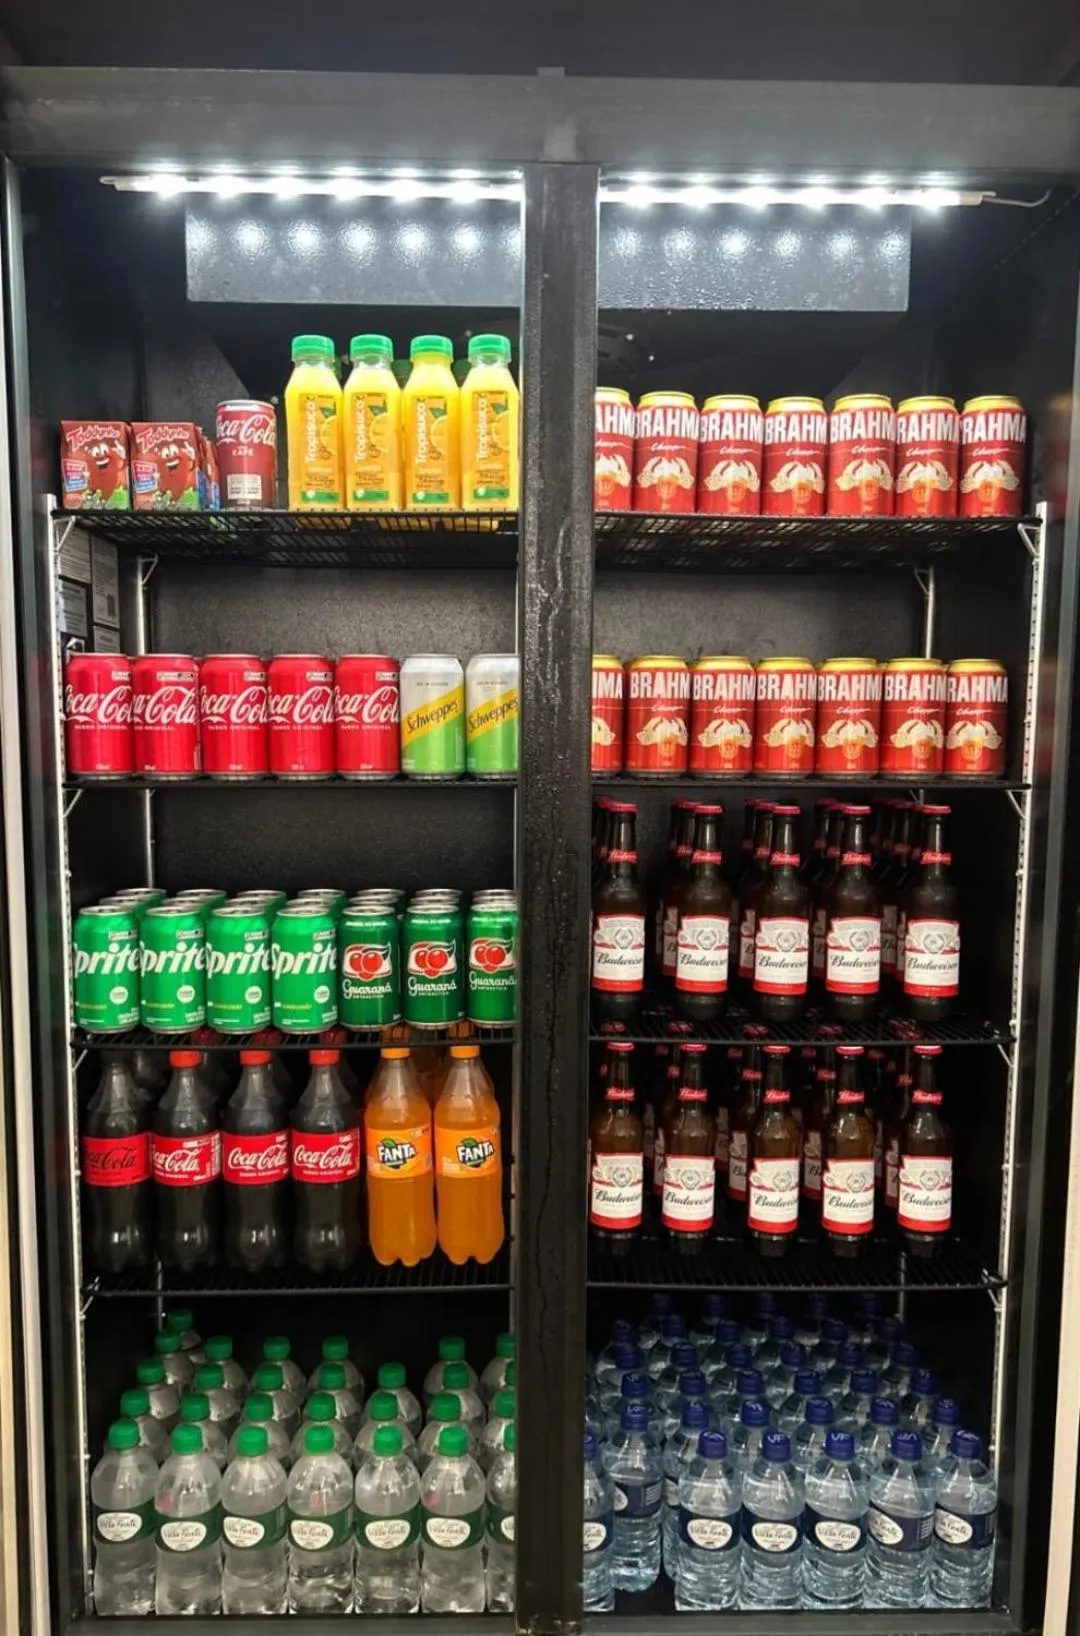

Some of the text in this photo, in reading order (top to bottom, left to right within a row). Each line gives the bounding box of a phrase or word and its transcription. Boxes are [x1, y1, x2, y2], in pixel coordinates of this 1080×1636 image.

[700, 411, 763, 443] BRAHM
[763, 413, 826, 445] BRAHM
[829, 410, 896, 443] BRAHM
[631, 671, 690, 699] BRAHM
[693, 673, 756, 700] BRAHM
[757, 673, 817, 700] BRAHM
[818, 675, 882, 701] BRAHM
[885, 674, 946, 701] BRAHM
[405, 698, 460, 734] Schweppes
[342, 979, 393, 1000] Guaraná
[407, 976, 457, 997] Guaraná
[378, 1144, 416, 1162] FANTA
[458, 1142, 494, 1162] FANTA
